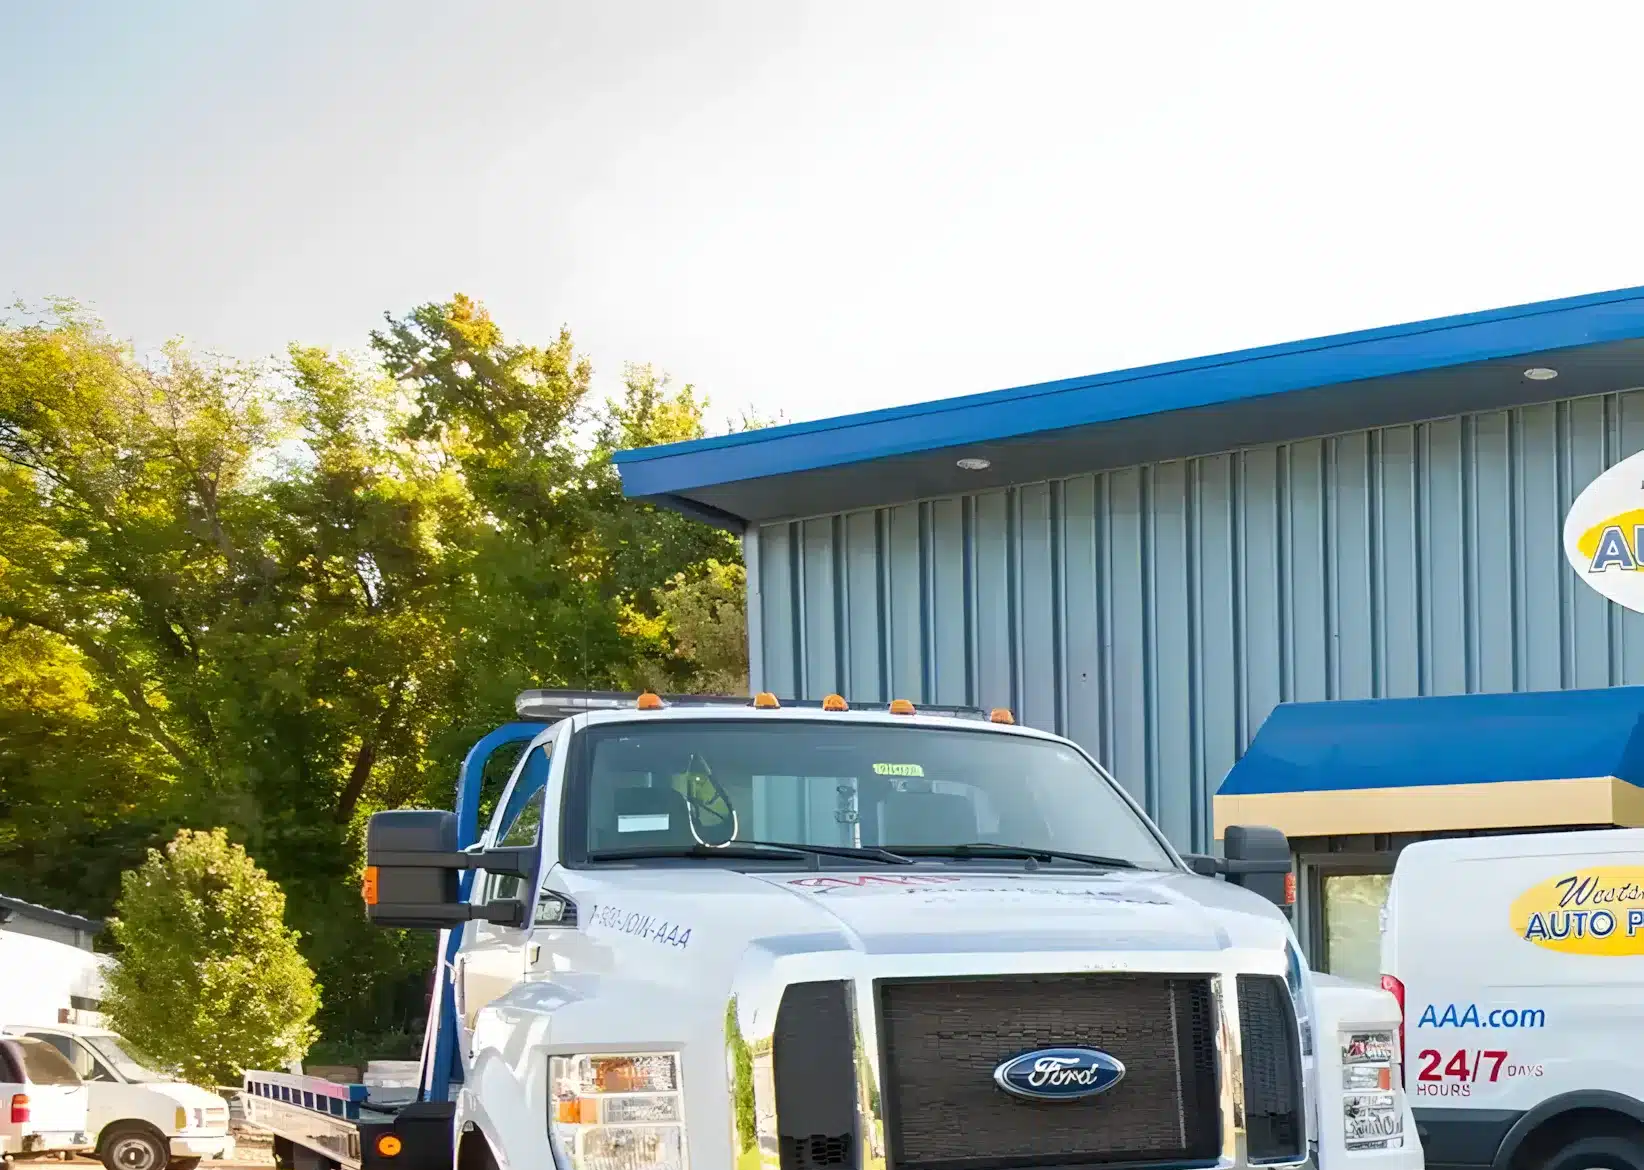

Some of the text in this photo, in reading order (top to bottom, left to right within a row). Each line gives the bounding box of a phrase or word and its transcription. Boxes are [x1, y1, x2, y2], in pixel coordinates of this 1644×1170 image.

[1524, 909, 1617, 941] AUTO
[1418, 1004, 1545, 1028] AAA.com
[1028, 1057, 1099, 1086] Ford
[1418, 1049, 1544, 1082] 24/7 DAYS
[1416, 1084, 1471, 1097] HOURS
